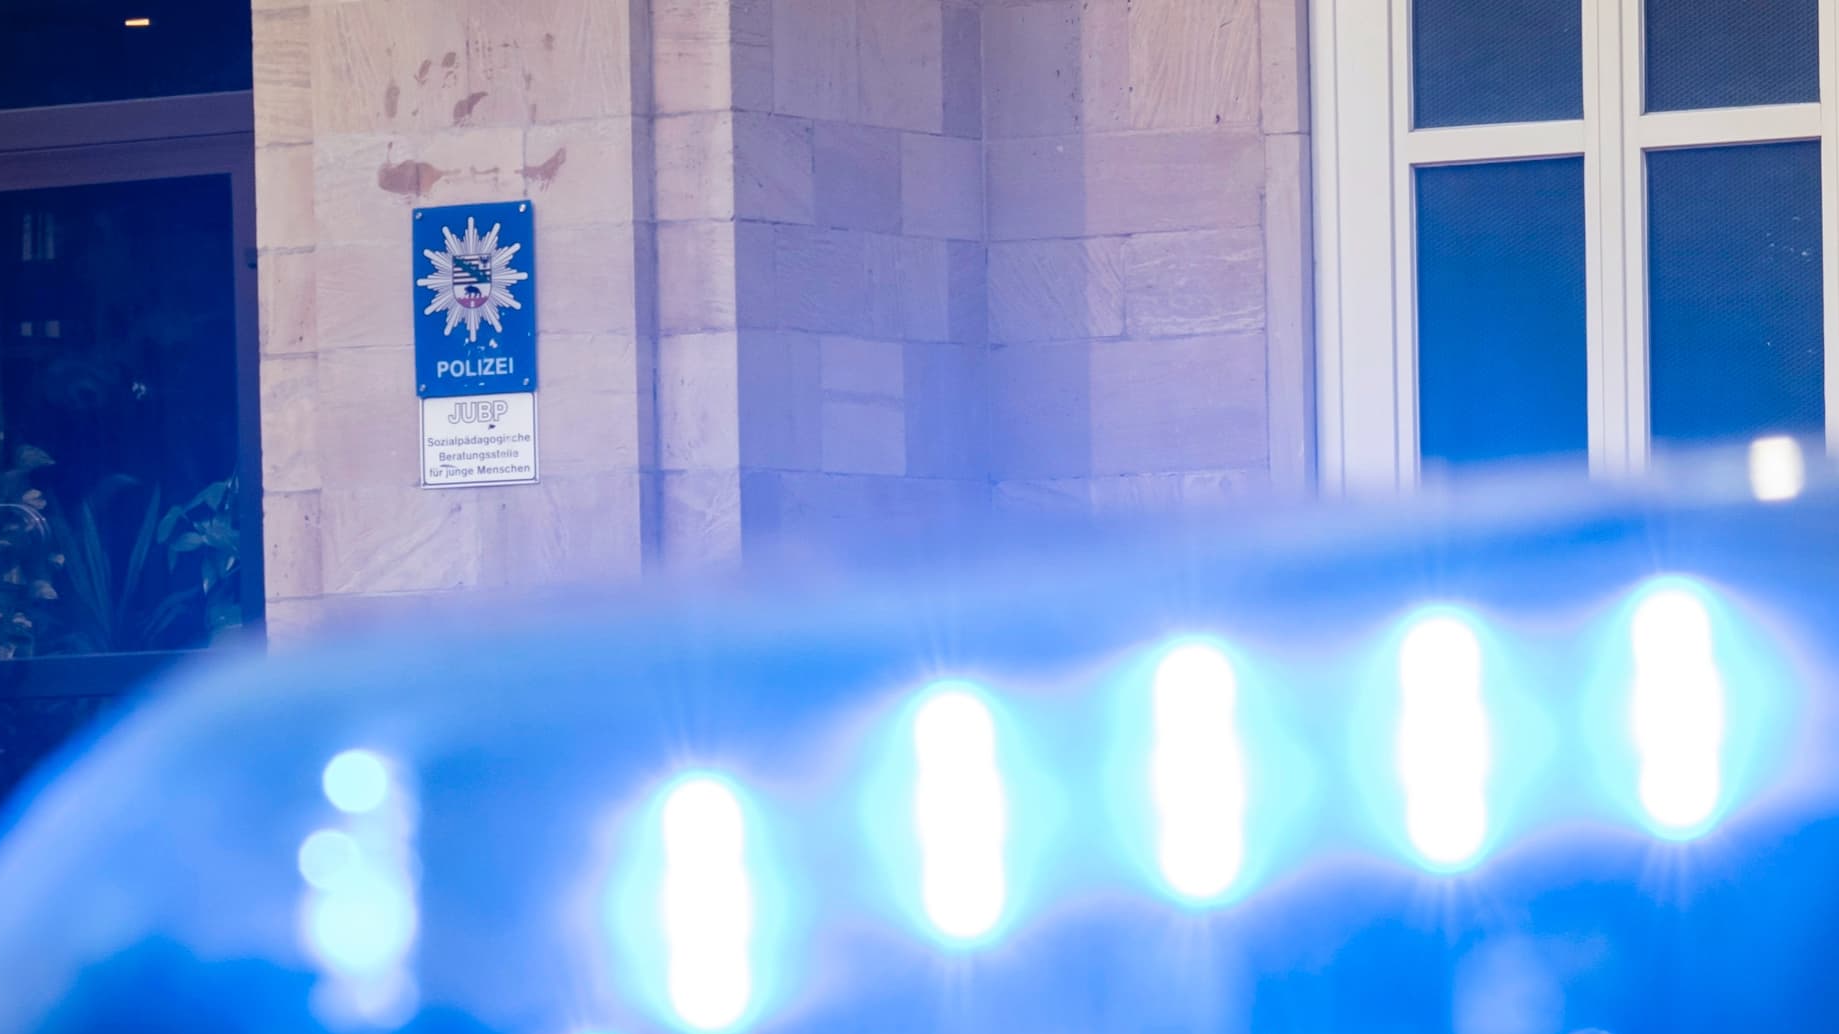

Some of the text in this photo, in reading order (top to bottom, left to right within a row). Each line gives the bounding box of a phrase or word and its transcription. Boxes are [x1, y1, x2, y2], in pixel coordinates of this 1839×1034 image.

[437, 357, 514, 378] POLIZEI
[448, 400, 508, 424] JUBP
[429, 463, 531, 479] für junge Menschen
